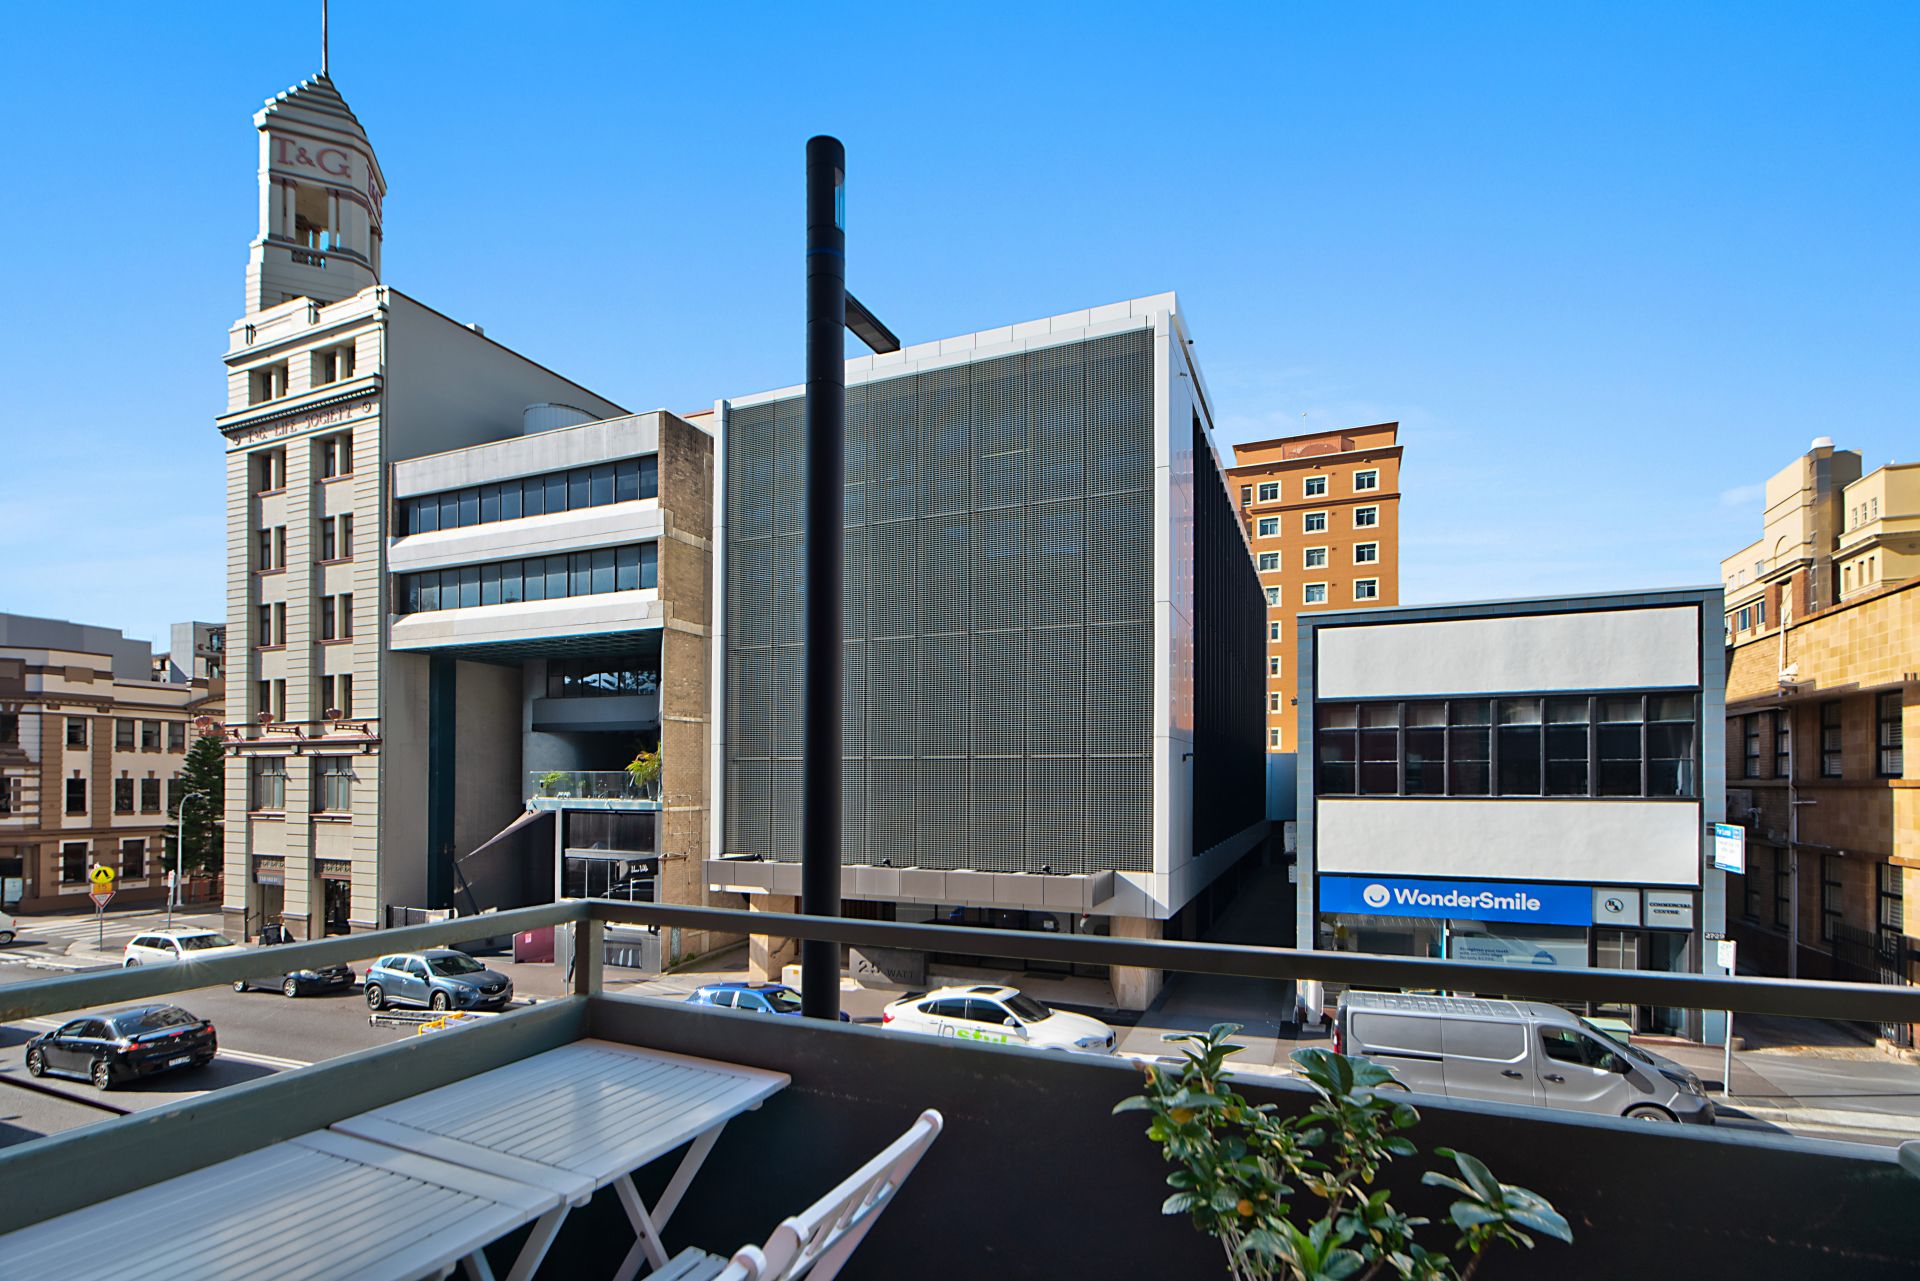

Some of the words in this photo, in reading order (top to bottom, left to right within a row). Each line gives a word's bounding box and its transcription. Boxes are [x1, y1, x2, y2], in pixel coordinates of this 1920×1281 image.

[275, 418, 298, 437] LIFE
[306, 403, 353, 430] SOCIETY
[1394, 888, 1541, 911] WonderSmile
[887, 968, 914, 979] WATT
